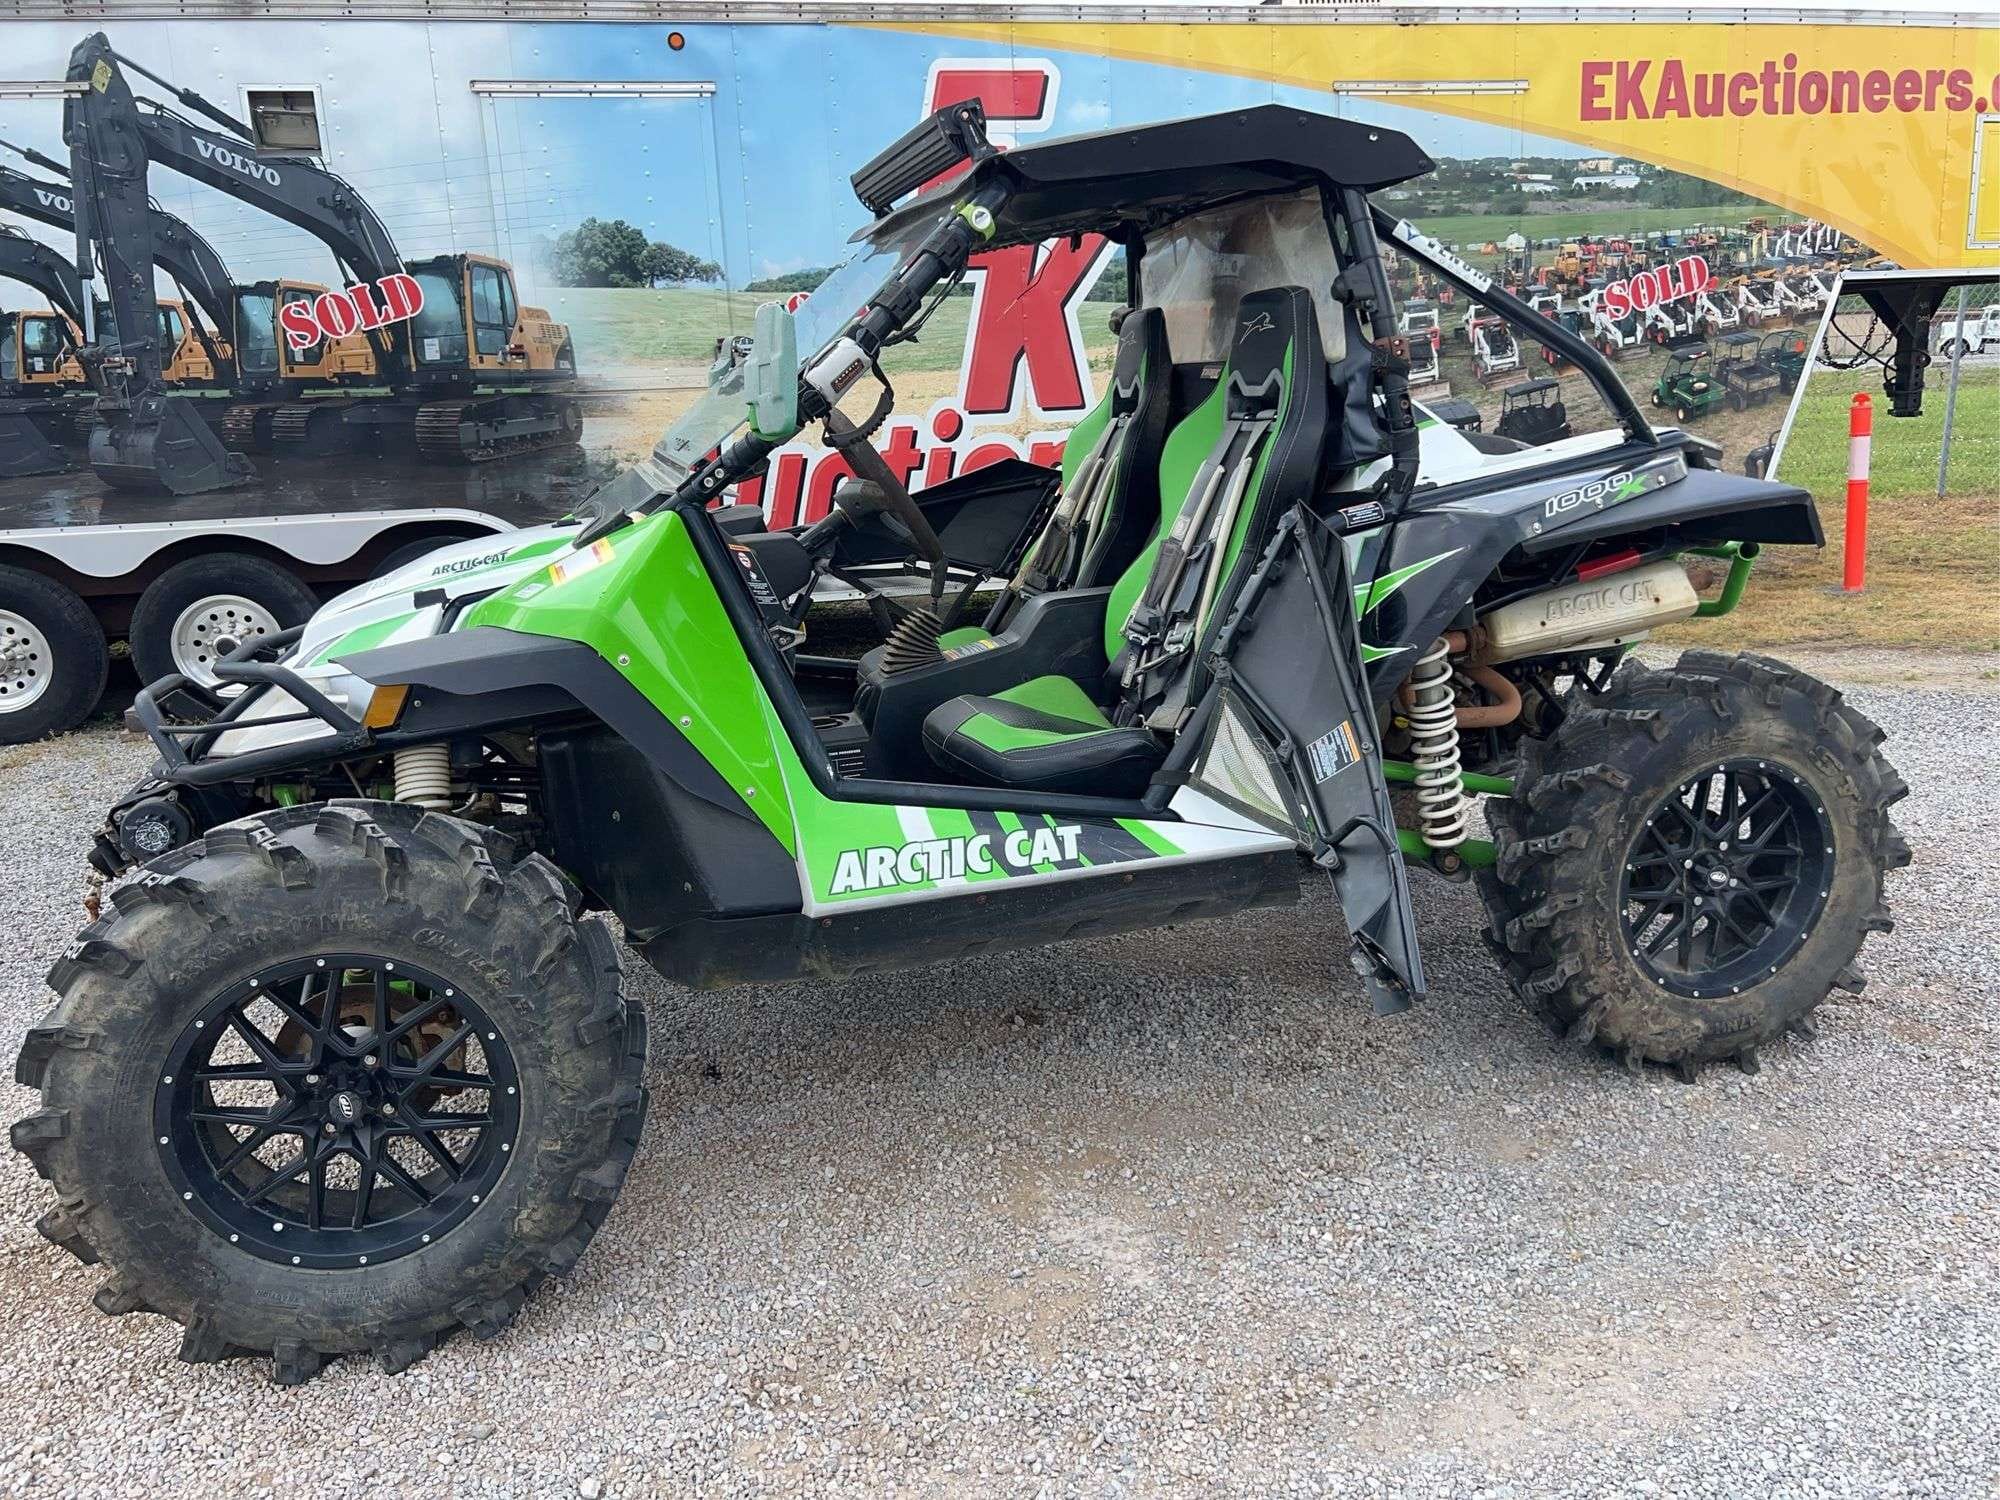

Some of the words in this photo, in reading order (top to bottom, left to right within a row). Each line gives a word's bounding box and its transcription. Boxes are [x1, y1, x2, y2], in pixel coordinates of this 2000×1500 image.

[192, 136, 281, 186] VOLVO
[280, 273, 423, 349] SOLD
[1604, 255, 1709, 320] SOLD
[432, 557, 482, 575] ARCTIC
[483, 551, 508, 566] CAT
[1546, 587, 1616, 620] ARCTIC
[1620, 579, 1655, 605] CAT
[828, 834, 994, 896] ARCTIC
[1004, 825, 1083, 868] CAT
